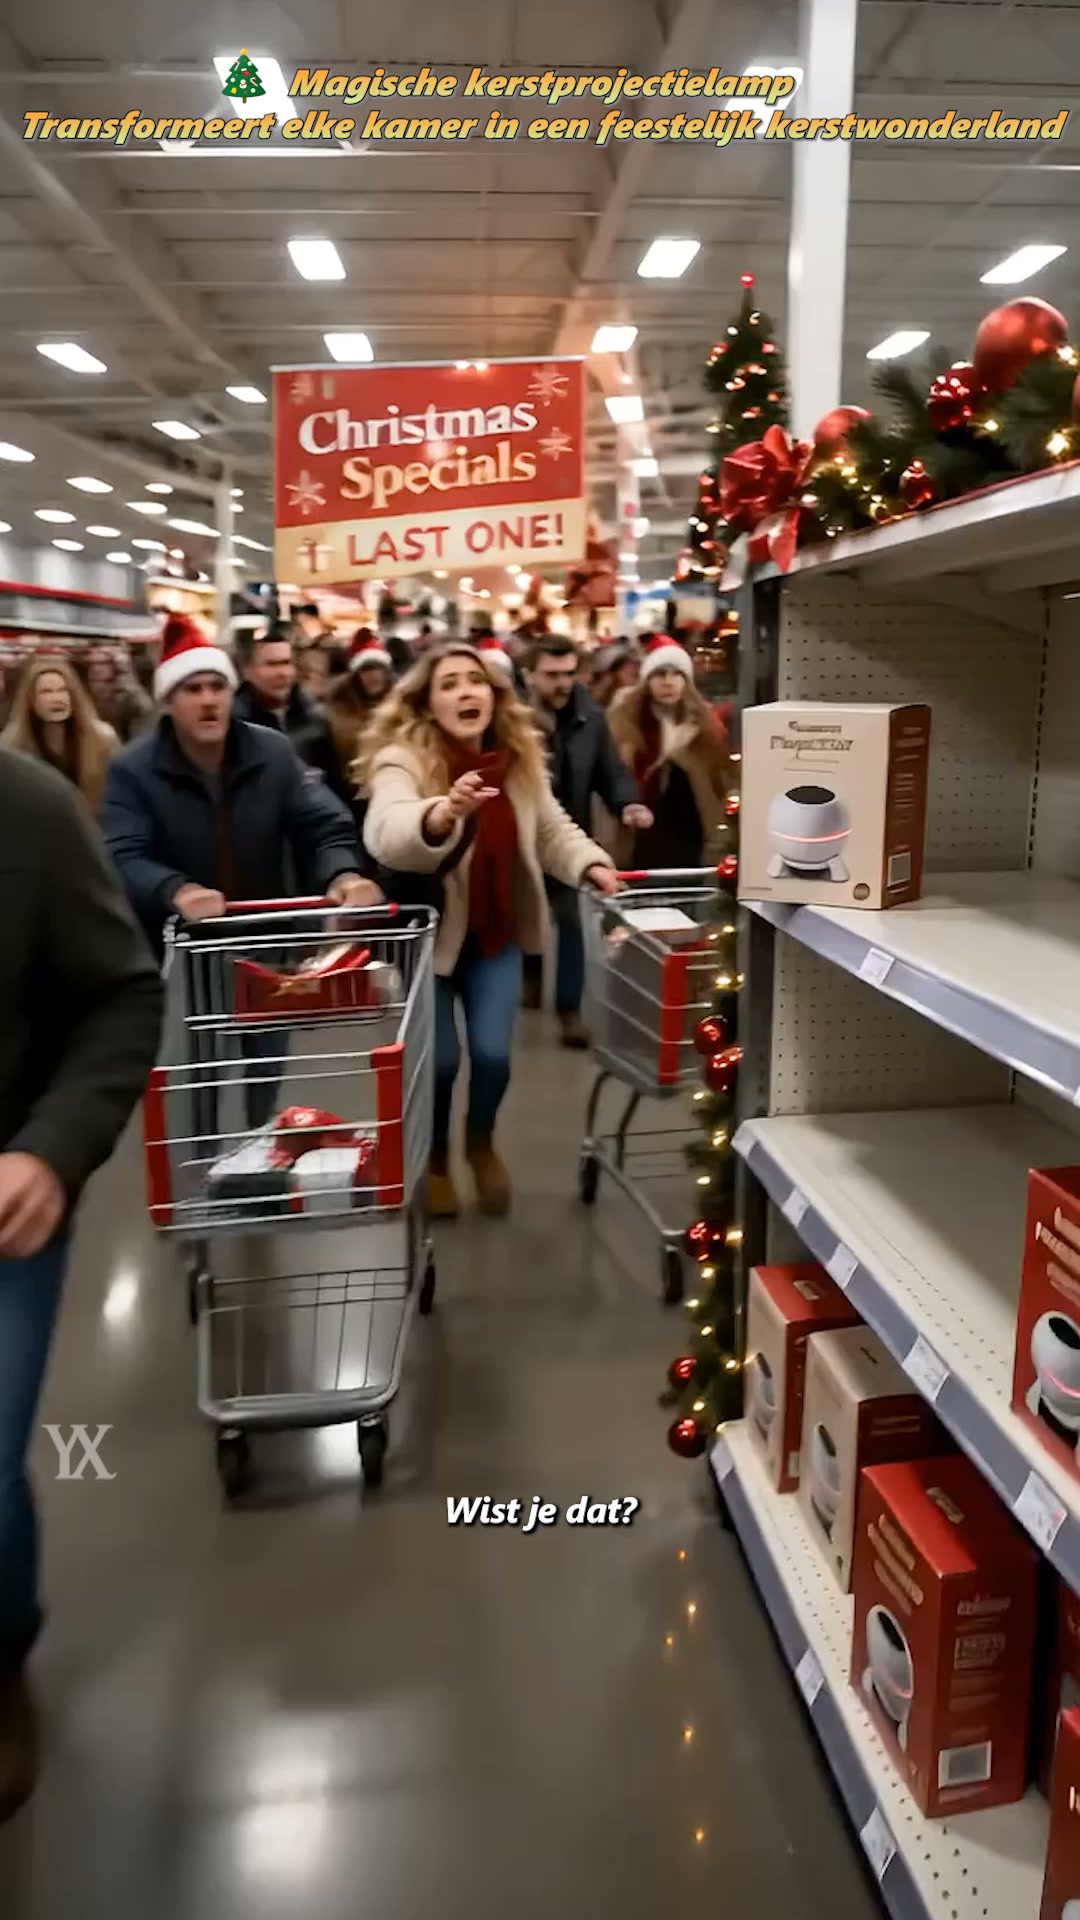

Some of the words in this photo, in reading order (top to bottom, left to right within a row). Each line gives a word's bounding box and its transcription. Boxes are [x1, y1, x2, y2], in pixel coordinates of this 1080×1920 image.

[298, 402, 538, 455] Christmas
[340, 440, 537, 509] Specials
[347, 525, 450, 566] LAST
[464, 512, 564, 554] ONE!
